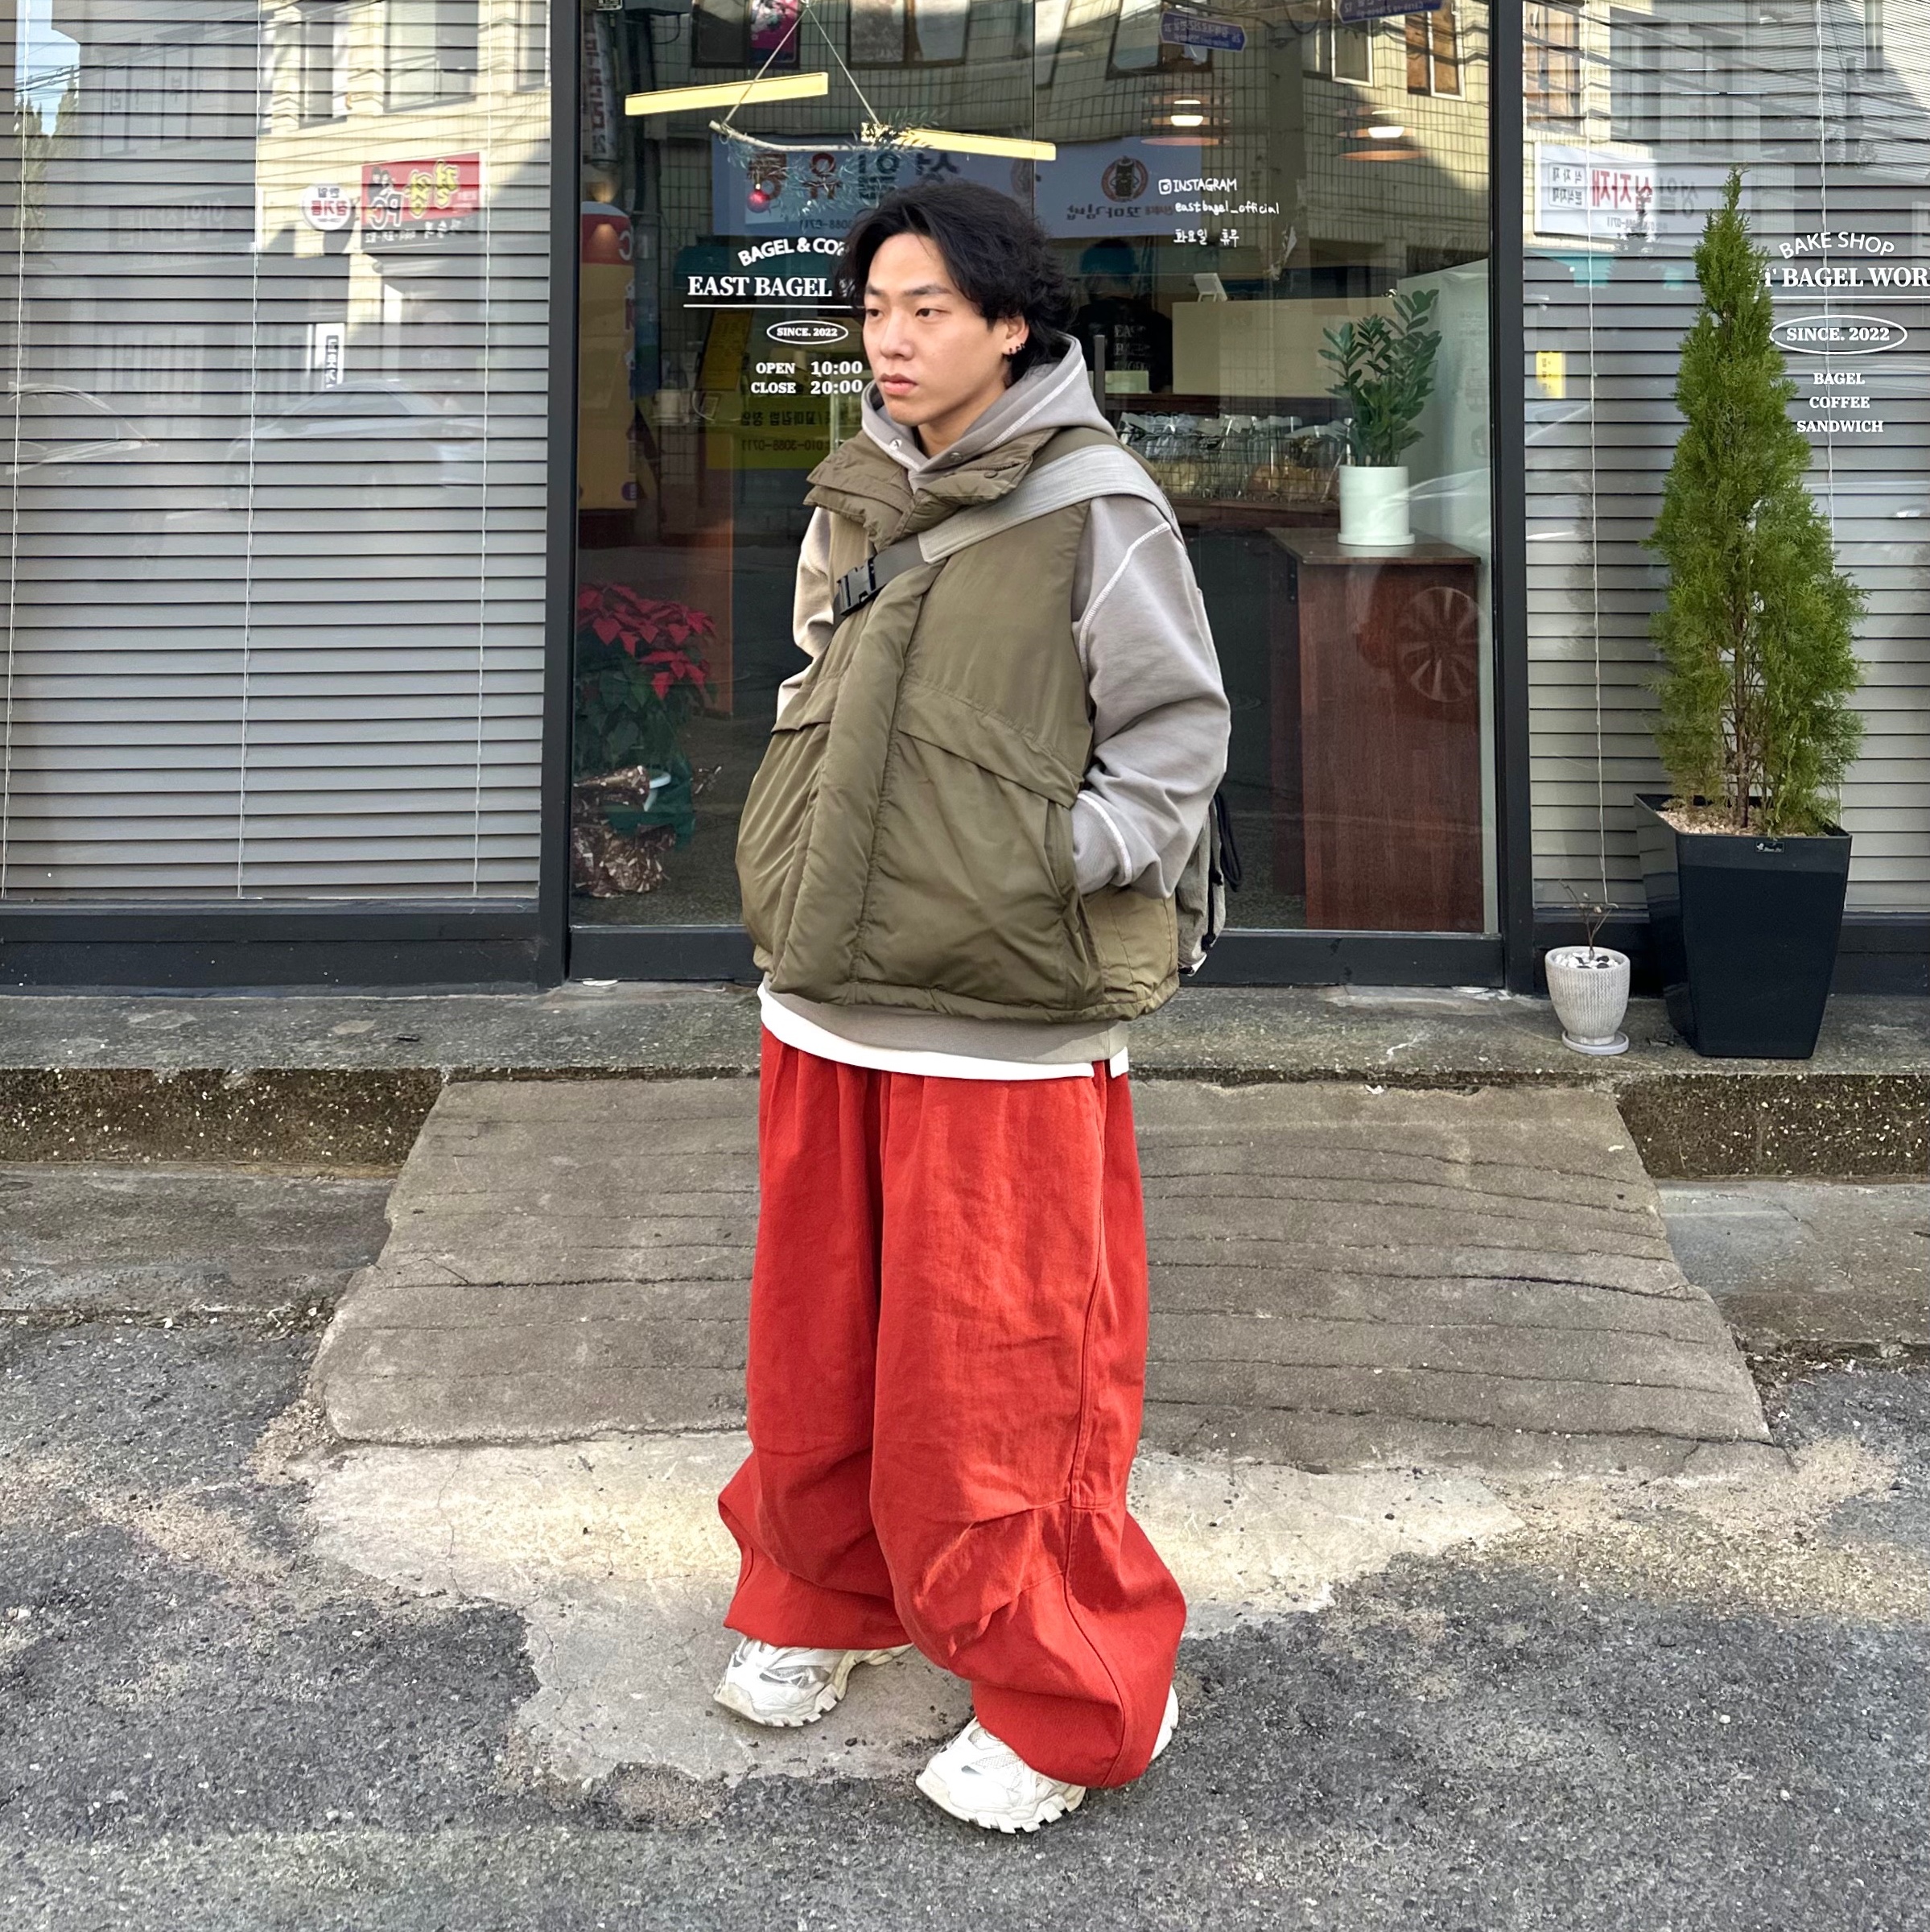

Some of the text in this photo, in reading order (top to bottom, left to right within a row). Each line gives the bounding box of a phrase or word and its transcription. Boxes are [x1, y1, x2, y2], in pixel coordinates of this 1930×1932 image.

[1173, 178, 1238, 193] INSTAGRAM
[1173, 228, 1239, 247] 화요일 휴무
[1779, 231, 1895, 258] BAKE SHOP
[737, 238, 795, 266] BAGEL
[797, 237, 811, 253] &
[1781, 267, 1864, 287] BAGEL
[1867, 266, 1930, 287] WOR
[687, 276, 749, 296] EAST
[754, 277, 832, 297] BAGEL
[777, 327, 838, 336] SINCE. 2022
[1786, 327, 1890, 341] SINCE. 2022
[756, 361, 863, 375] OPEN 10:00
[1812, 372, 1866, 385] BAGEL
[751, 380, 863, 394] CLOSE 20:00
[1808, 396, 1870, 409] COFFEE
[1796, 420, 1884, 432] SANDWICH
